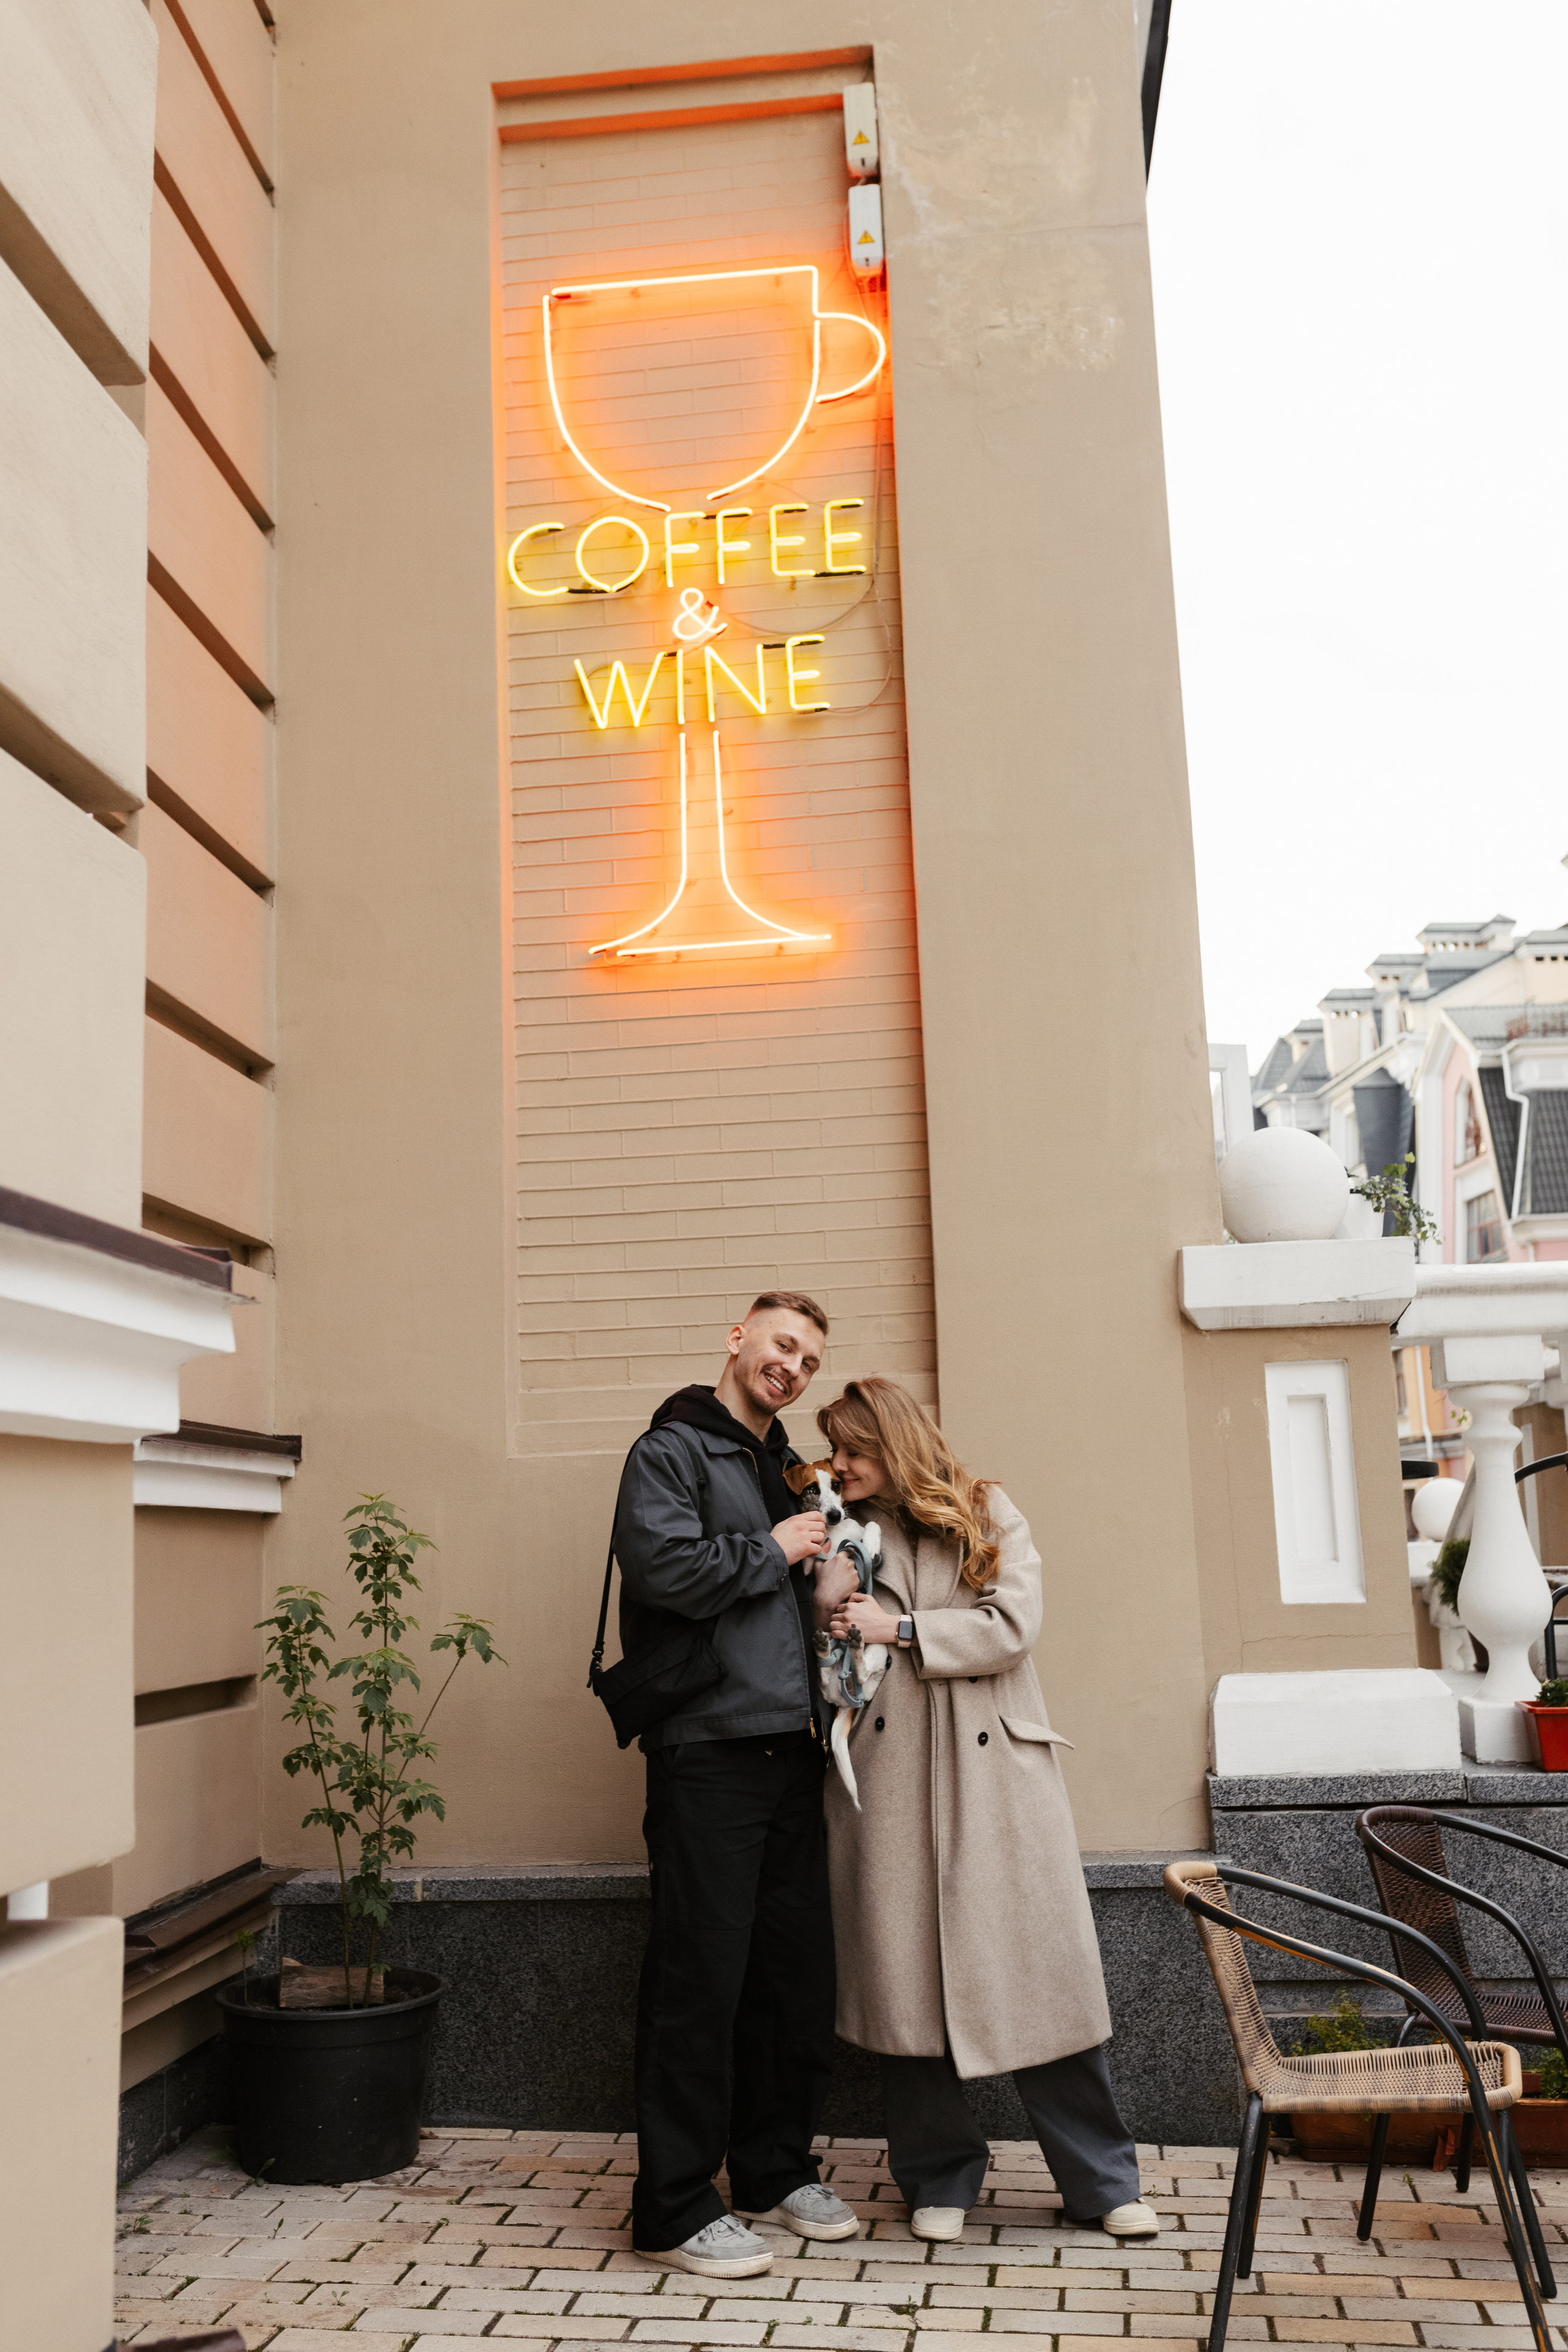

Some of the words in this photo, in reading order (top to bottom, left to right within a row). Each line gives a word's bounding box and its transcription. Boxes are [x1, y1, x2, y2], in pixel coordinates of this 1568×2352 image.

[508, 499, 867, 596] COFFEE
[673, 587, 728, 640] &
[574, 634, 831, 729] WINE
